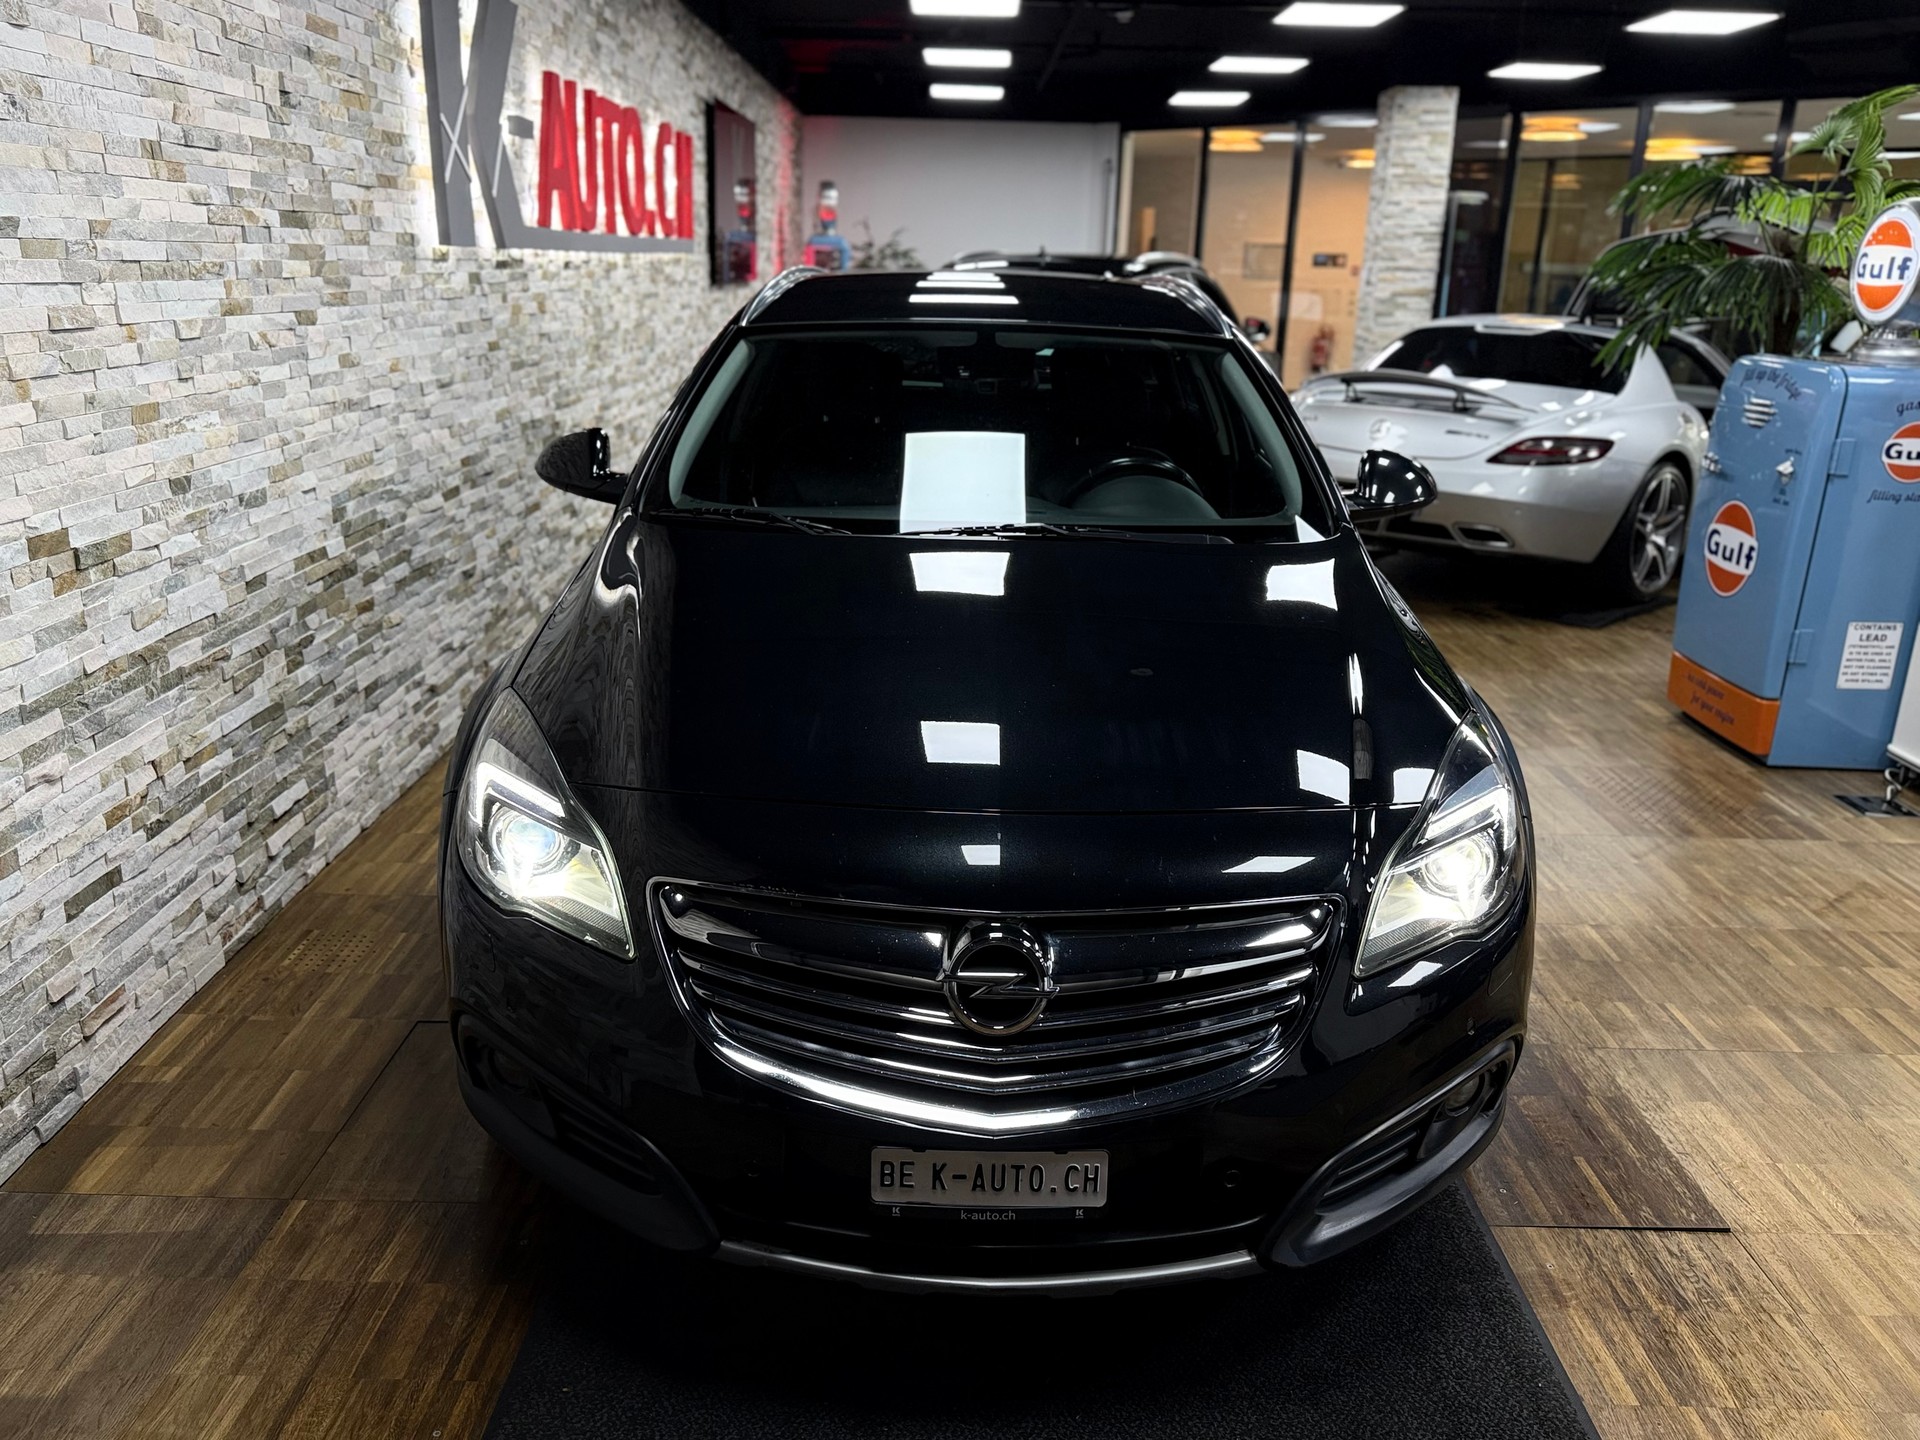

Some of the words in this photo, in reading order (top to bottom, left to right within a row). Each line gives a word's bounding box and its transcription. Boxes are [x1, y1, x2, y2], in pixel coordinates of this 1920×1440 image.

[1857, 252, 1913, 280] Gulf
[1866, 489, 1902, 505] filling
[1707, 528, 1756, 570] Gulf
[1859, 633, 1888, 642] LEAD
[879, 1160, 916, 1189] BE
[931, 1162, 1101, 1193] K-AUTO.CH
[960, 1209, 1016, 1221] k-auto.ch
